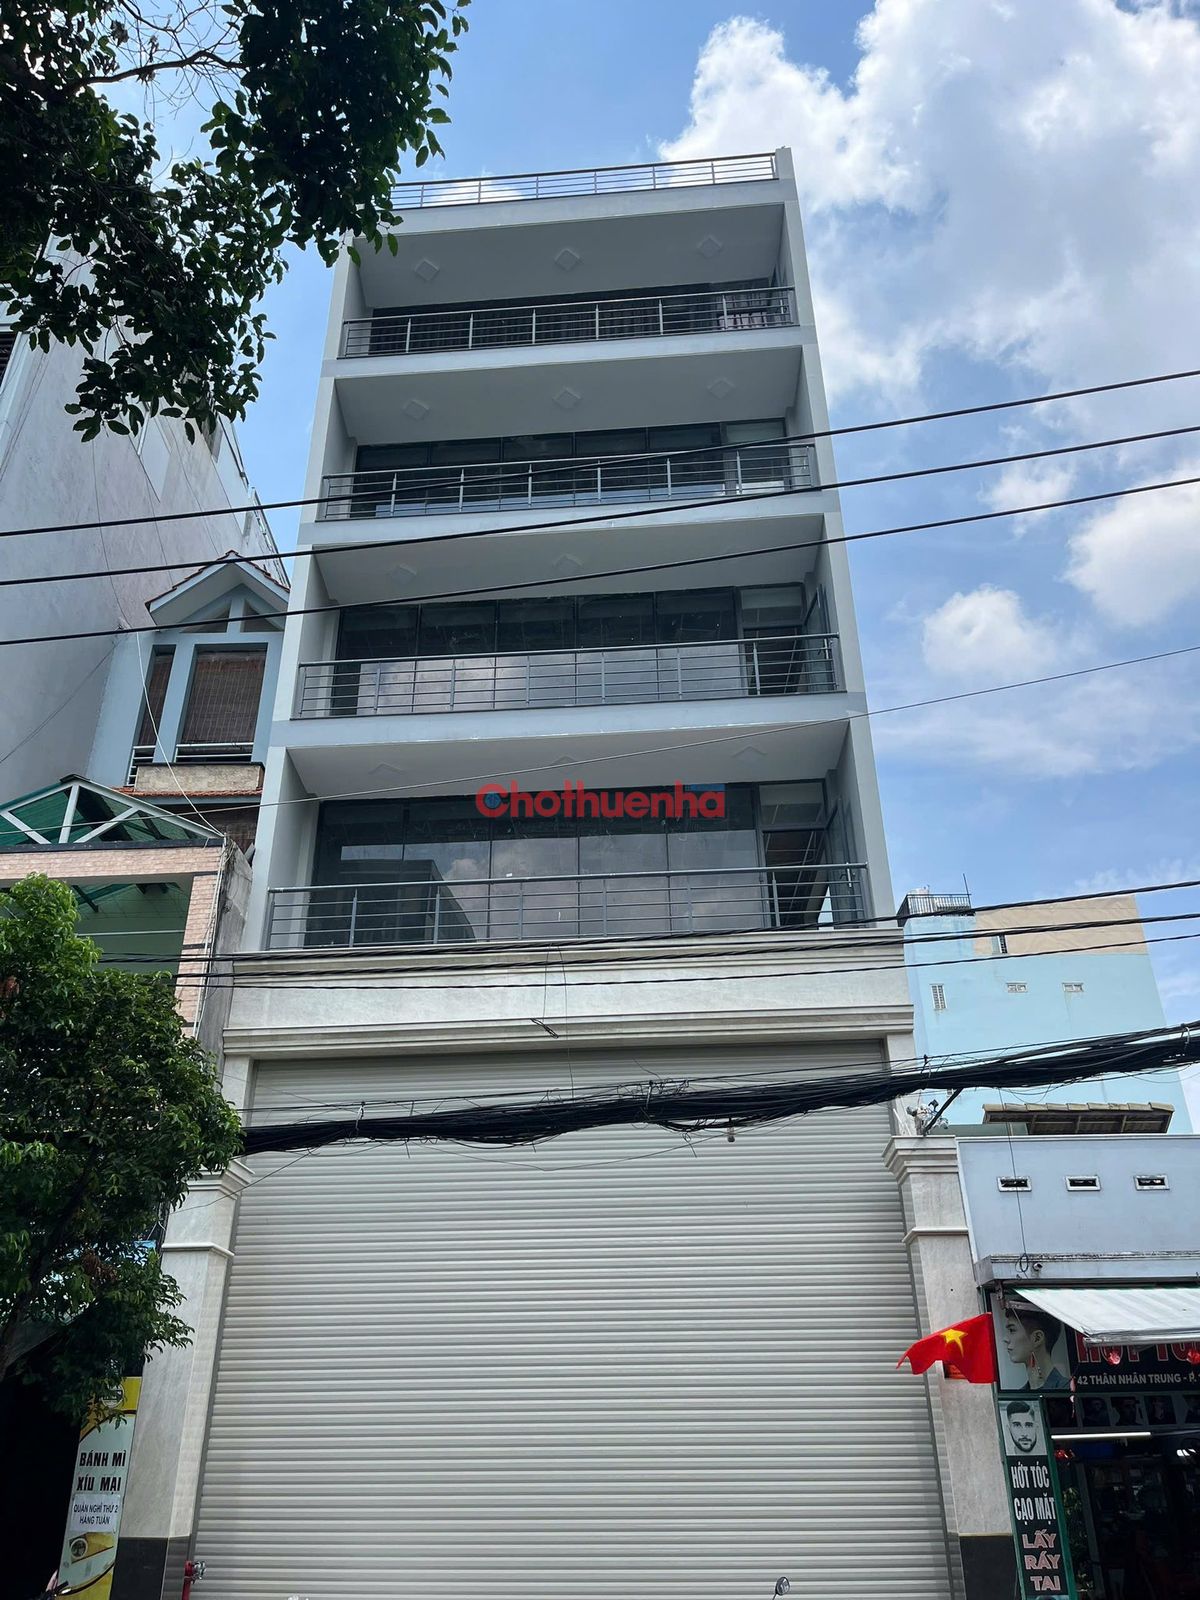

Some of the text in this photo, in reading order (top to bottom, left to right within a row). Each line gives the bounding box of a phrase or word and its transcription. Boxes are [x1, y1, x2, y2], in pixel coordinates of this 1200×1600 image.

[1077, 1375, 1088, 1385] 42
[1089, 1372, 1117, 1385] THÂN
[1147, 1373, 1181, 1384] TRUNG
[79, 1450, 109, 1467] BÁNH
[1011, 1461, 1050, 1488] HỚT TÓC
[76, 1474, 121, 1495] XÍU MẠI
[114, 1505, 119, 1513] 2
[1014, 1492, 1056, 1525] CẠO MẶT
[1022, 1529, 1057, 1549] LẤY
[1024, 1551, 1061, 1570] RÁY
[1030, 1575, 1061, 1591] TAI
